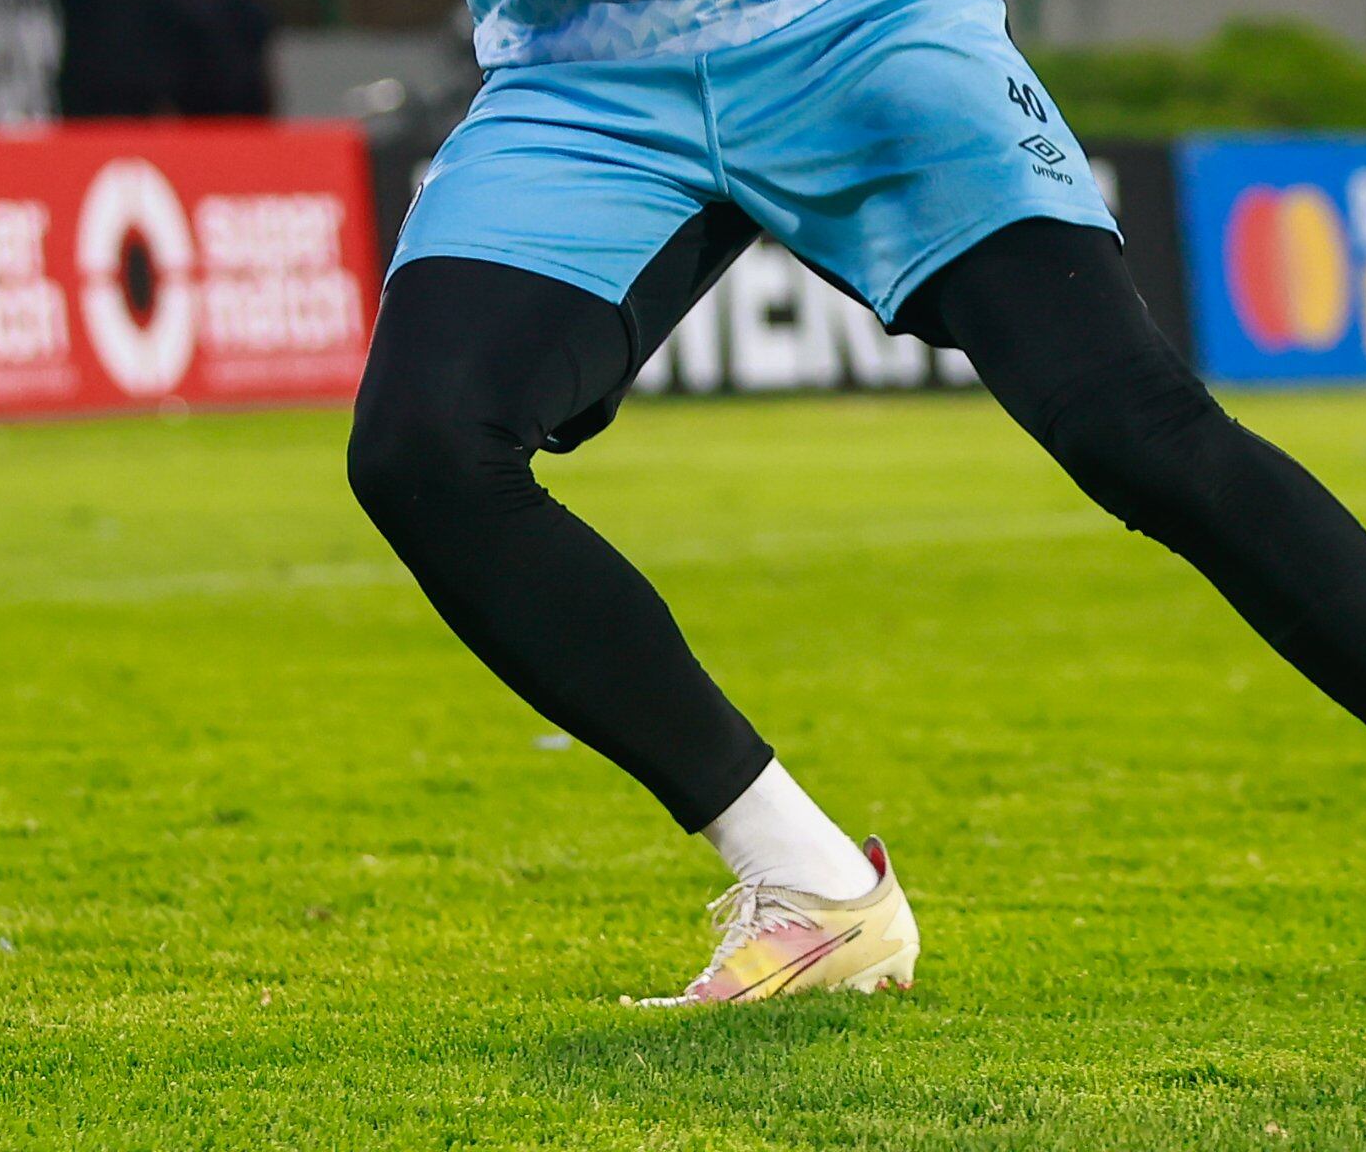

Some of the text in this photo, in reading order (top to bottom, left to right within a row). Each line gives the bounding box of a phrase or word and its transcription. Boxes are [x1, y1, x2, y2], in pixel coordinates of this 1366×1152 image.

[1006, 76, 1048, 123] 40
[1031, 163, 1074, 186] umbro
[197, 192, 346, 276] super
[201, 270, 367, 351] match
